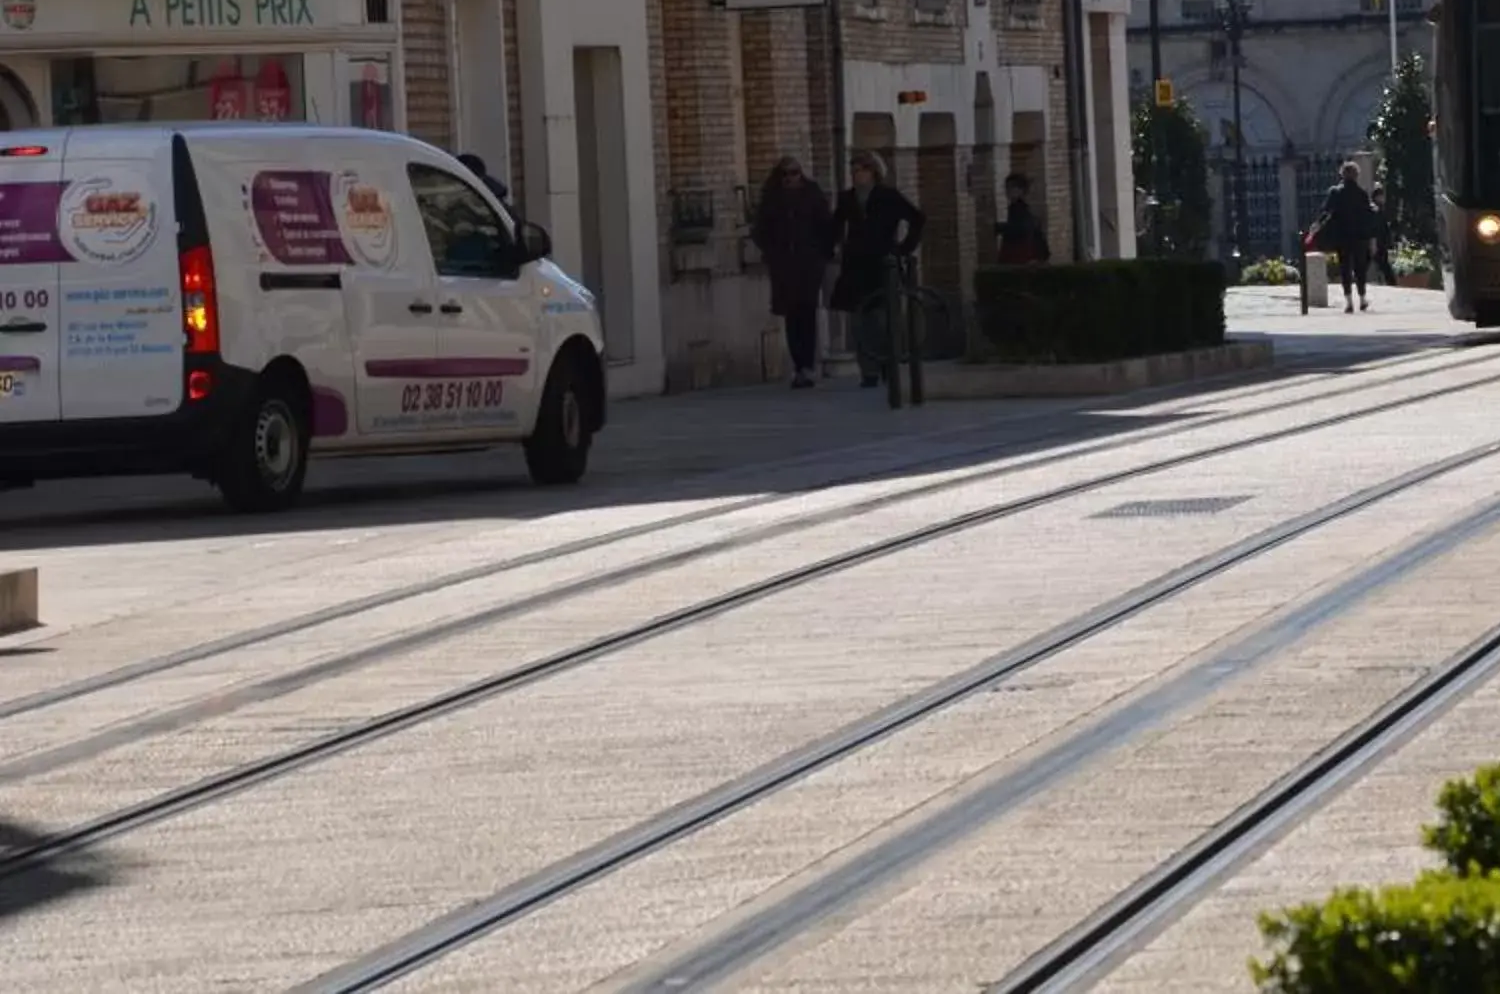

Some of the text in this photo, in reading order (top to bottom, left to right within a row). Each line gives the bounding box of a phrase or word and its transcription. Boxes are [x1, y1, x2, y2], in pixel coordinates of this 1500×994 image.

[24, 289, 49, 309] 00
[402, 379, 503, 413] 02 38 51 10 00
